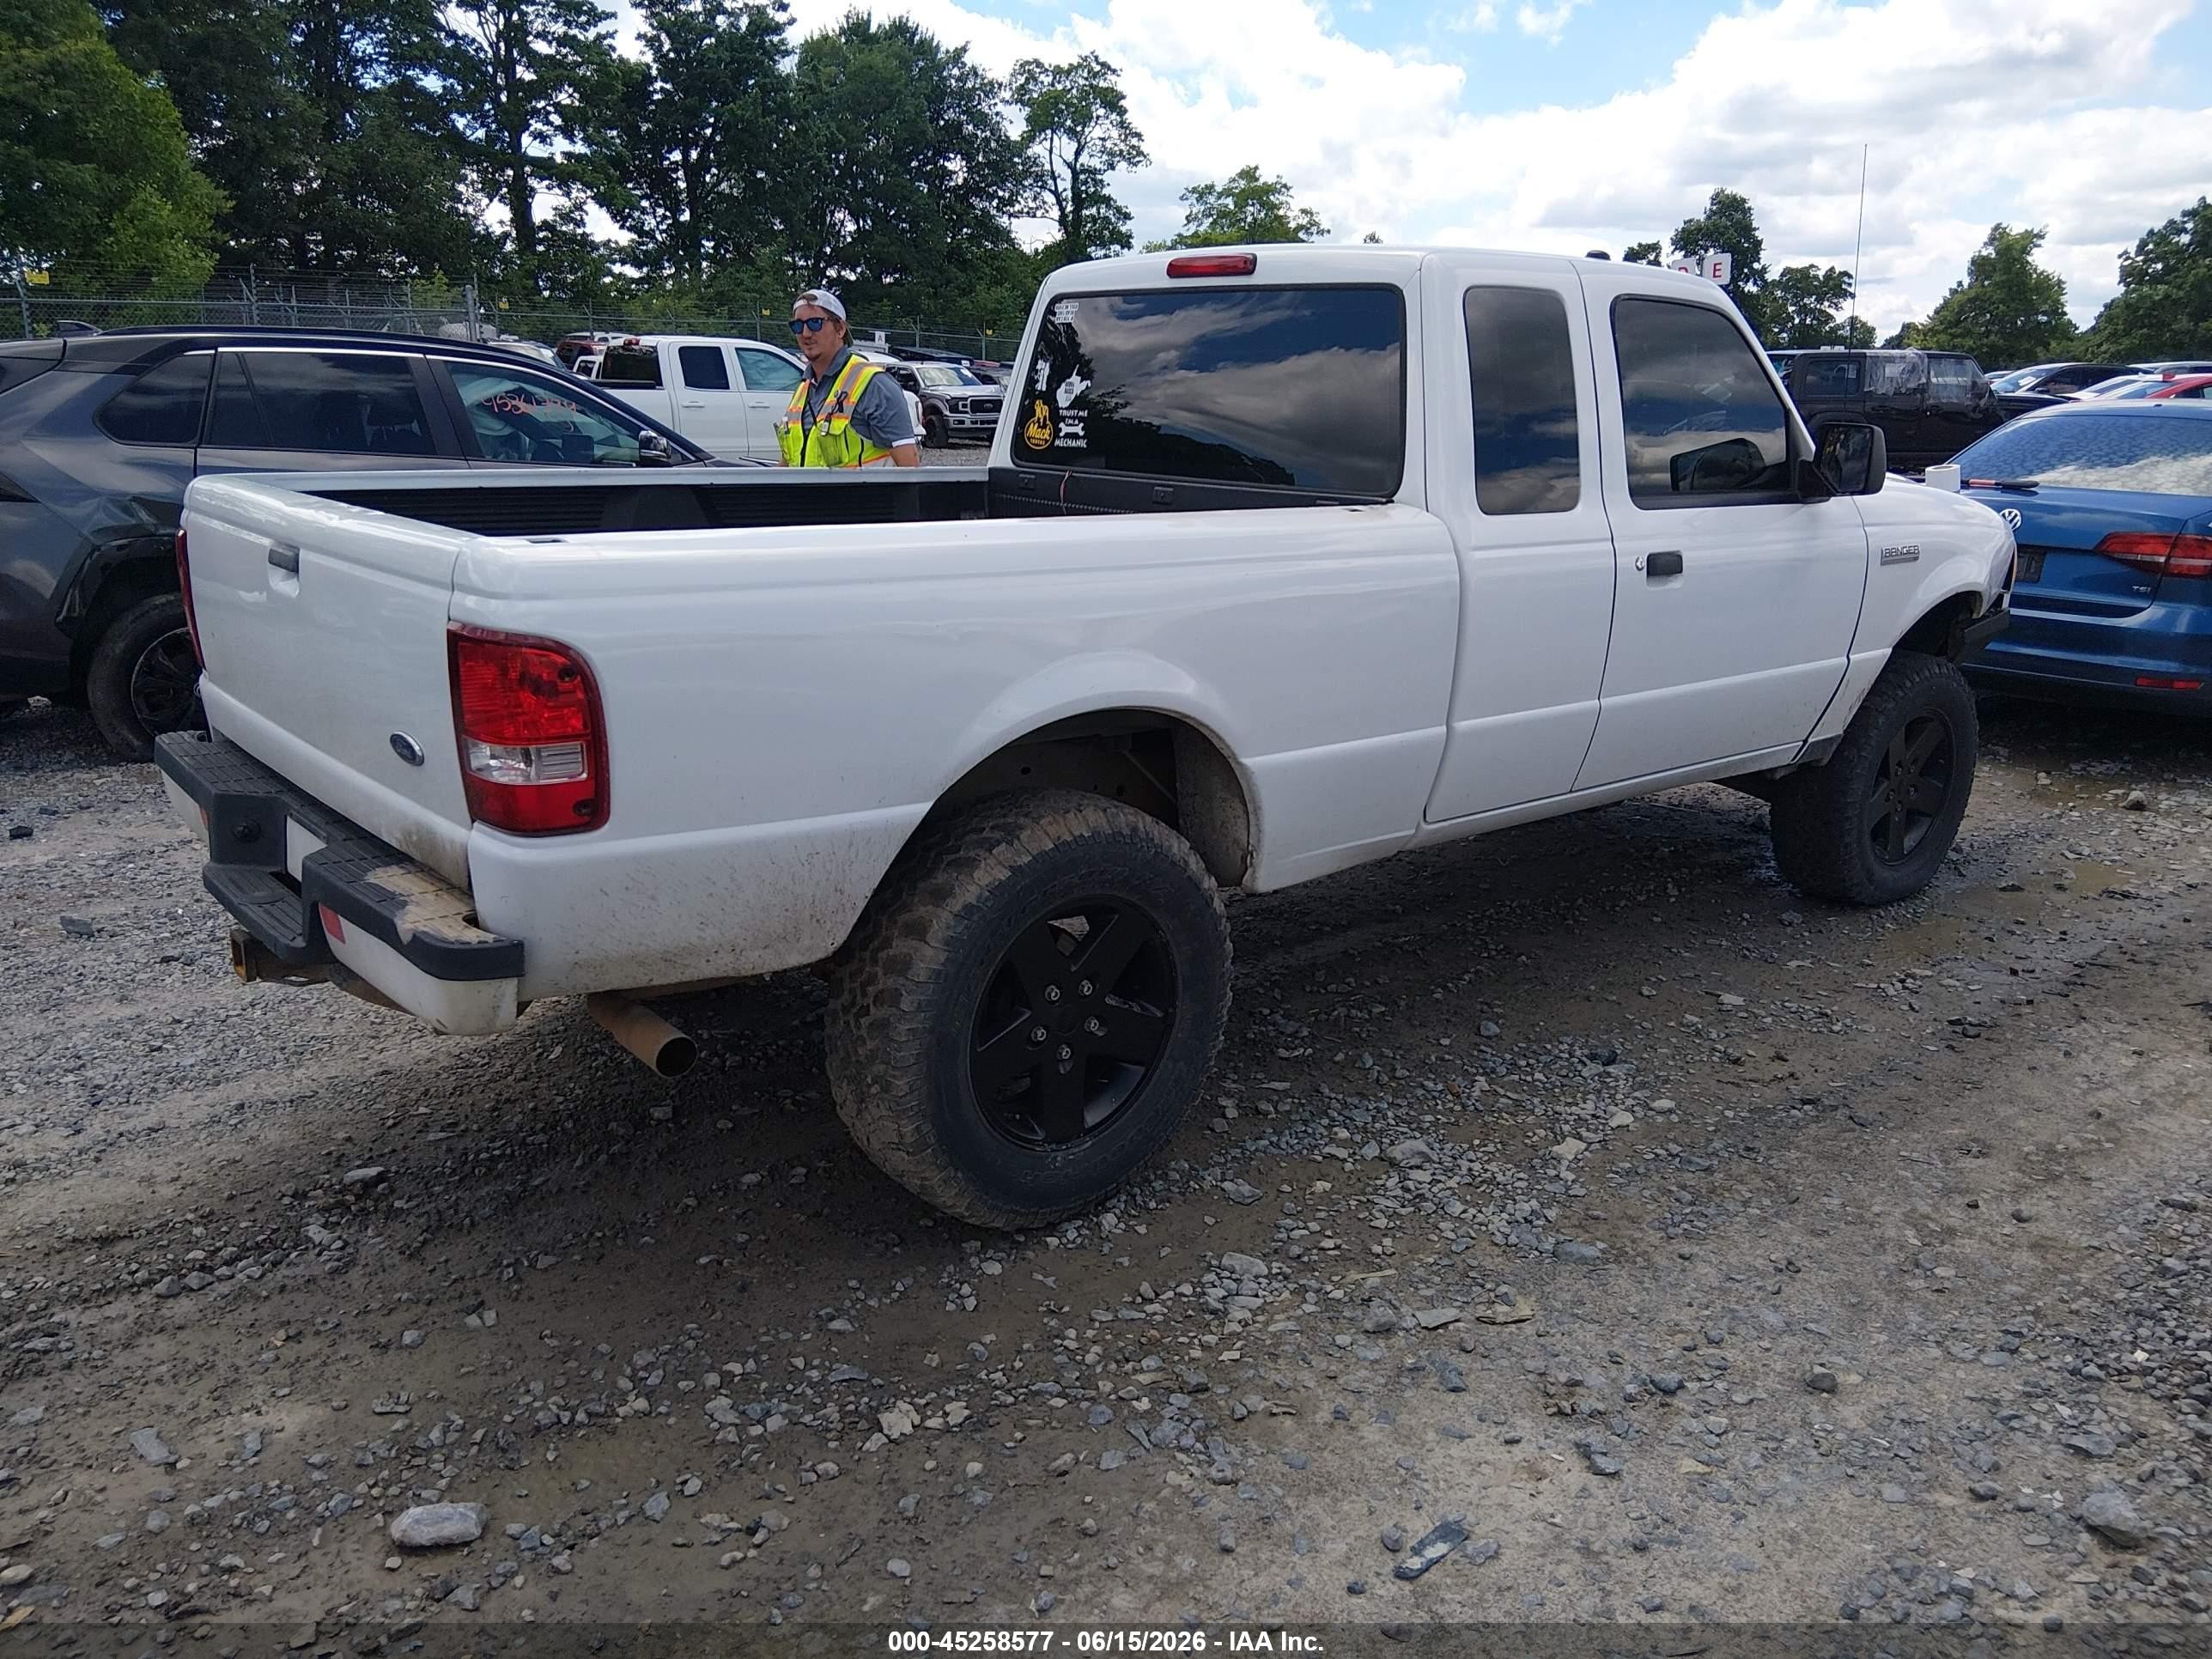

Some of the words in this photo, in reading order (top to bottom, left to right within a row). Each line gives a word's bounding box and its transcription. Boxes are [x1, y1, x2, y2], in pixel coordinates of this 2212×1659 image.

[1713, 262, 1723, 278] E
[1027, 422, 1050, 440] Mack
[1054, 438, 1087, 447] MECHANIC
[1884, 544, 1920, 558] RANGER
